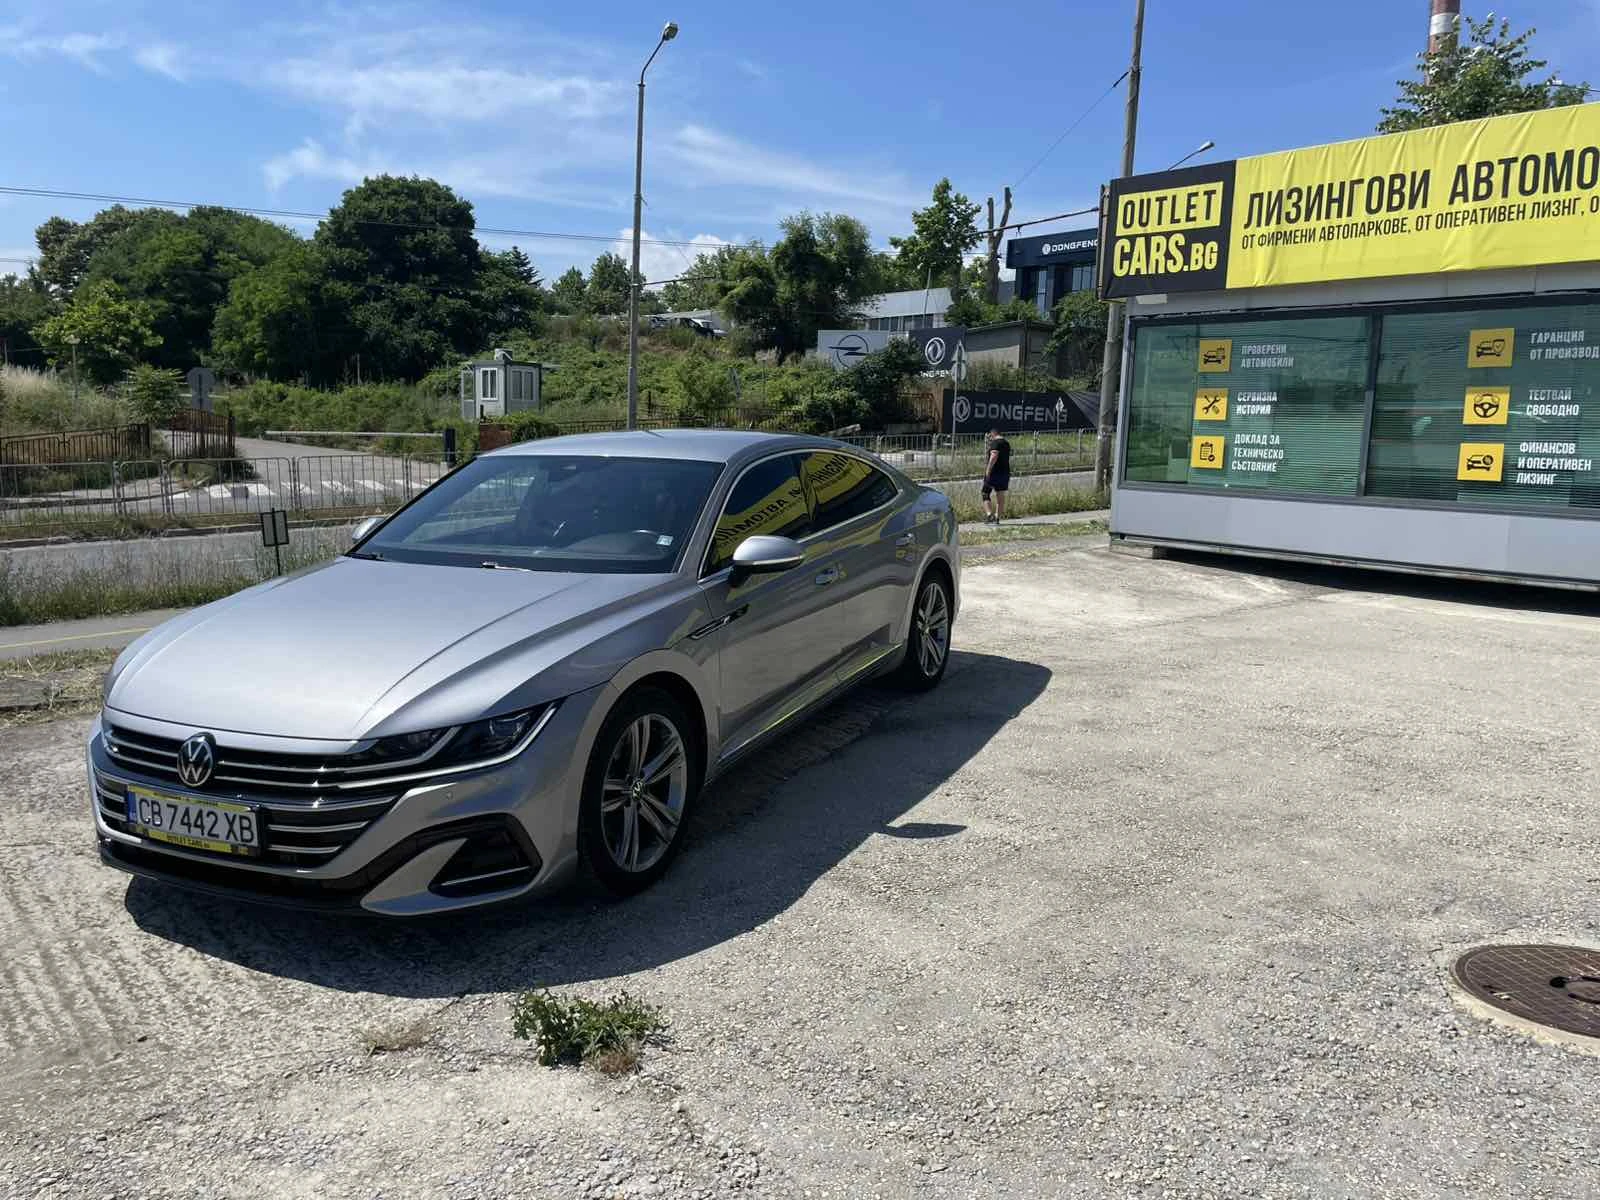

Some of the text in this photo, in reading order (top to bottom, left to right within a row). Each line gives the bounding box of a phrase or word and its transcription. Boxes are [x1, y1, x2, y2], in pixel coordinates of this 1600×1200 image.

[1243, 146, 1600, 229] ЛИЗИНГОВИ АВТОМО
[1121, 189, 1217, 230] OUTLET
[1242, 235, 1254, 250] ОТ
[1257, 228, 1317, 247] ФИРМЕНИ
[1319, 217, 1412, 243] АВТОПАРКОВЕ,
[1415, 214, 1433, 232] ОТ
[1435, 203, 1527, 229] ОПЕРАТИВЕН
[1113, 232, 1218, 278] CARS.BG
[1530, 330, 1585, 344] ГАРАНЦИЯ
[1241, 344, 1287, 355] ПРОВЕРЕНИ
[1530, 346, 1600, 361] ОТ ПРОИЗВОД
[1240, 357, 1294, 369] АВТОМОБИЛИ
[1237, 391, 1278, 402] СЕРВИЗНА
[1528, 387, 1572, 401] ТЕСТВАЙ
[974, 402, 1068, 422] DONGFENG
[1236, 404, 1271, 415] ИСТОРИЯ
[1526, 404, 1579, 417] СВОБОДНО
[1234, 433, 1280, 445] ДОКЛАД ЗА
[1233, 447, 1284, 459] ТЕХНИЧЕСКО
[1519, 442, 1576, 454] ФИНАНСОВ
[1232, 461, 1277, 472] СЪСТОЯНИЕ
[1517, 457, 1592, 471] И ОПЕРАТИВЕН
[1516, 473, 1556, 485] ЛИЗИНГ
[138, 798, 163, 827] CB
[166, 804, 219, 838] 7442
[224, 812, 255, 843] XB
